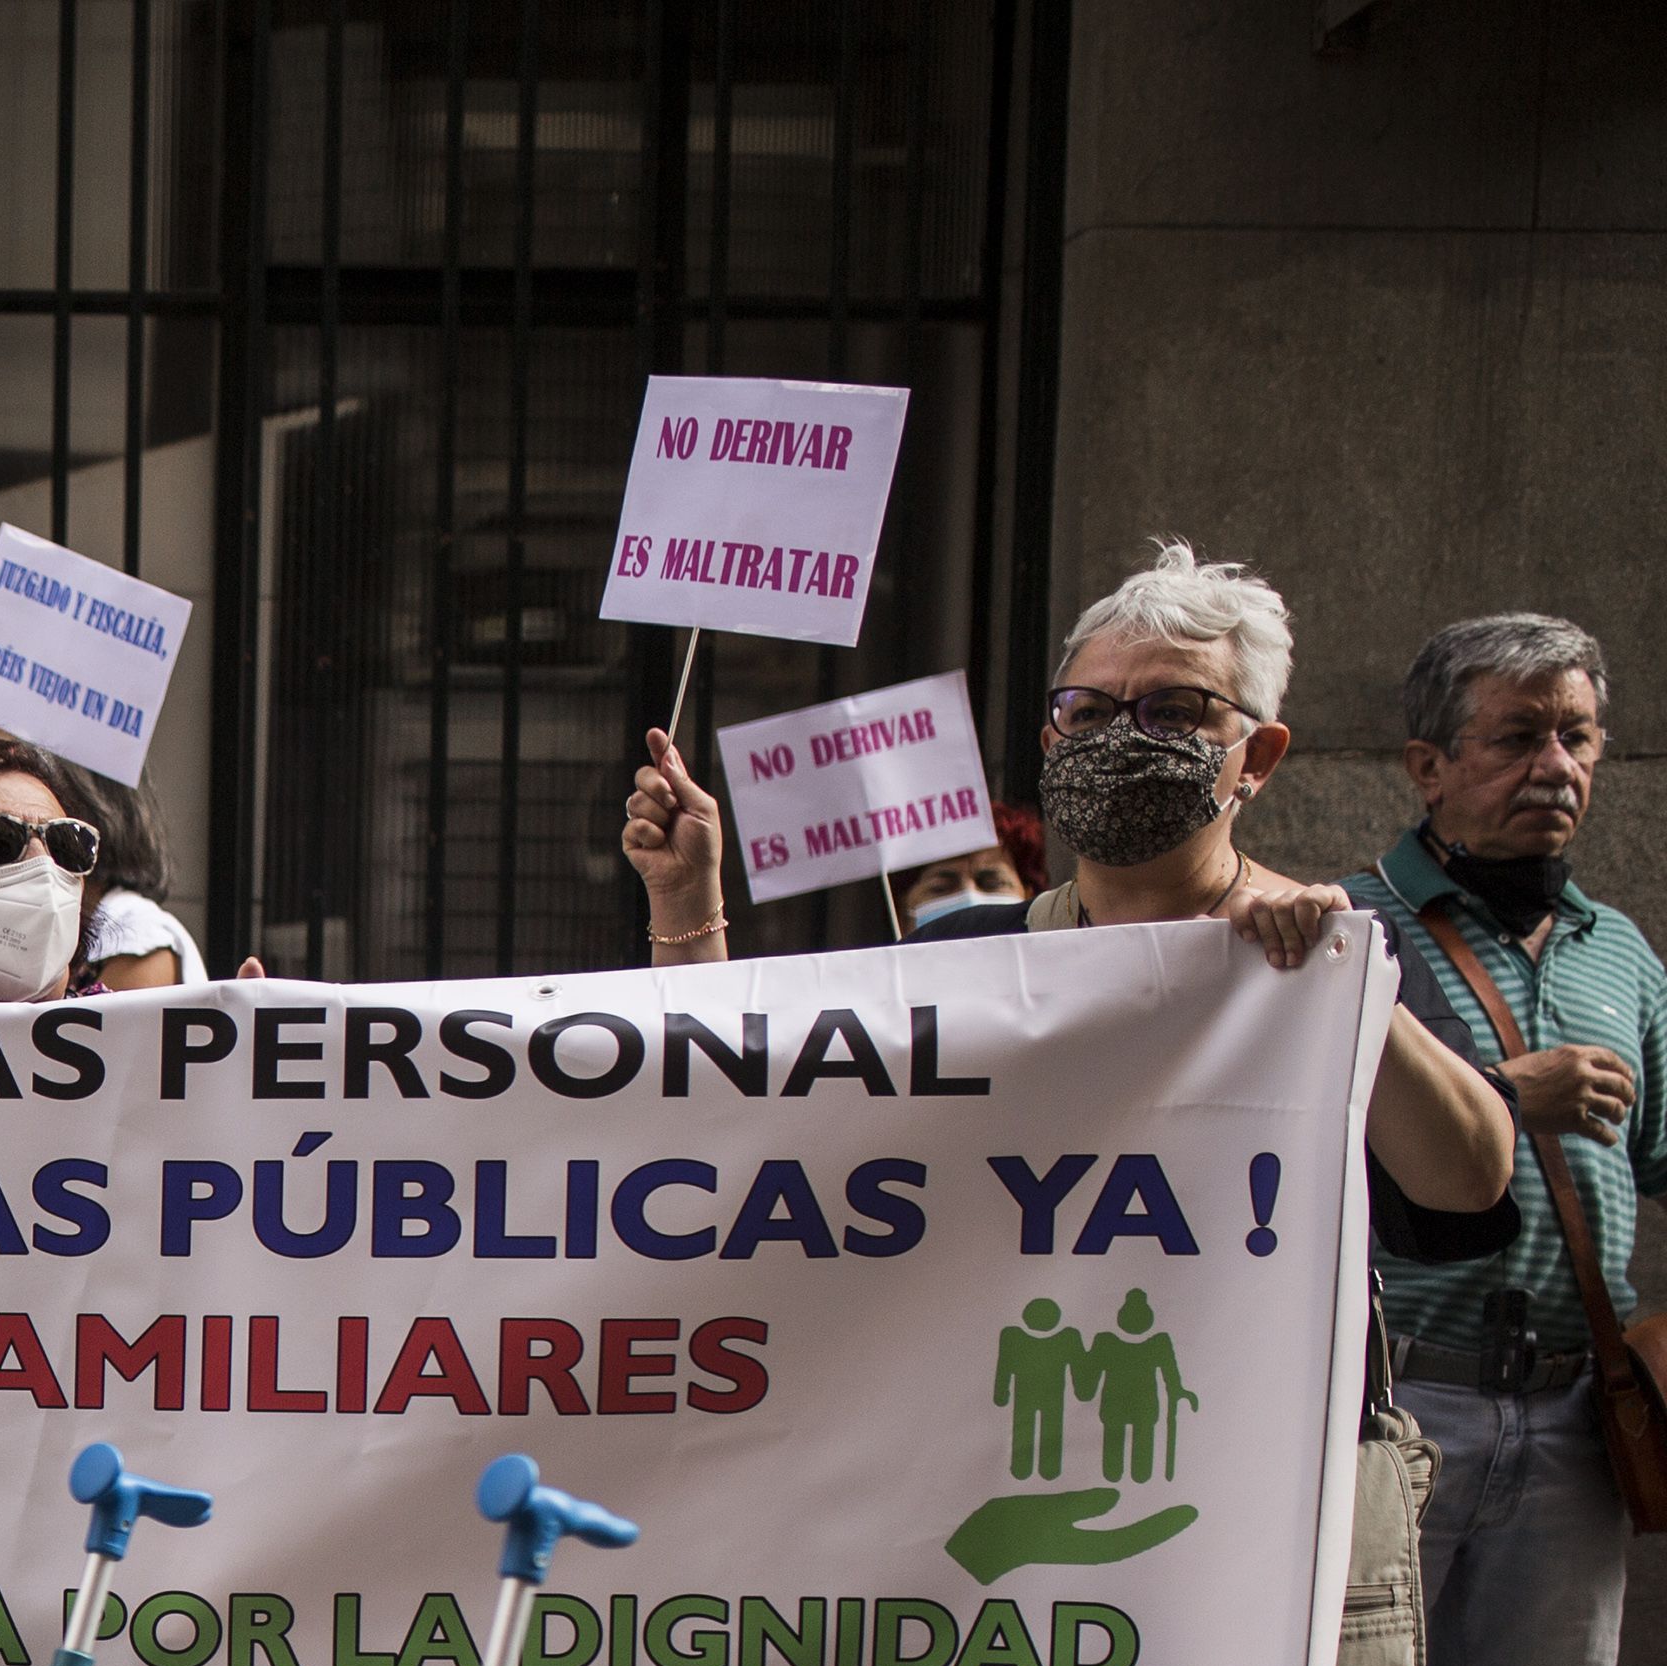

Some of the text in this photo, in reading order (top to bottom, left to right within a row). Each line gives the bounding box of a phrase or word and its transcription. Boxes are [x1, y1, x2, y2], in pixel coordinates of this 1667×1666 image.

[656, 416, 853, 471] NO DERIVAR
[617, 535, 859, 599] ES MALTRATAR
[73, 590, 87, 621] Y
[86, 597, 168, 661] FISCALÍA,
[28, 661, 82, 710] VIEJOS
[81, 687, 109, 721] UN
[108, 700, 145, 738] DIA
[749, 707, 936, 783] NO DERIVAR
[750, 786, 979, 871] ES MALTRATAR
[160, 1005, 991, 1100] PERSONAL
[161, 1131, 927, 1260] PÚBLICAS
[986, 1153, 1201, 1256] YA
